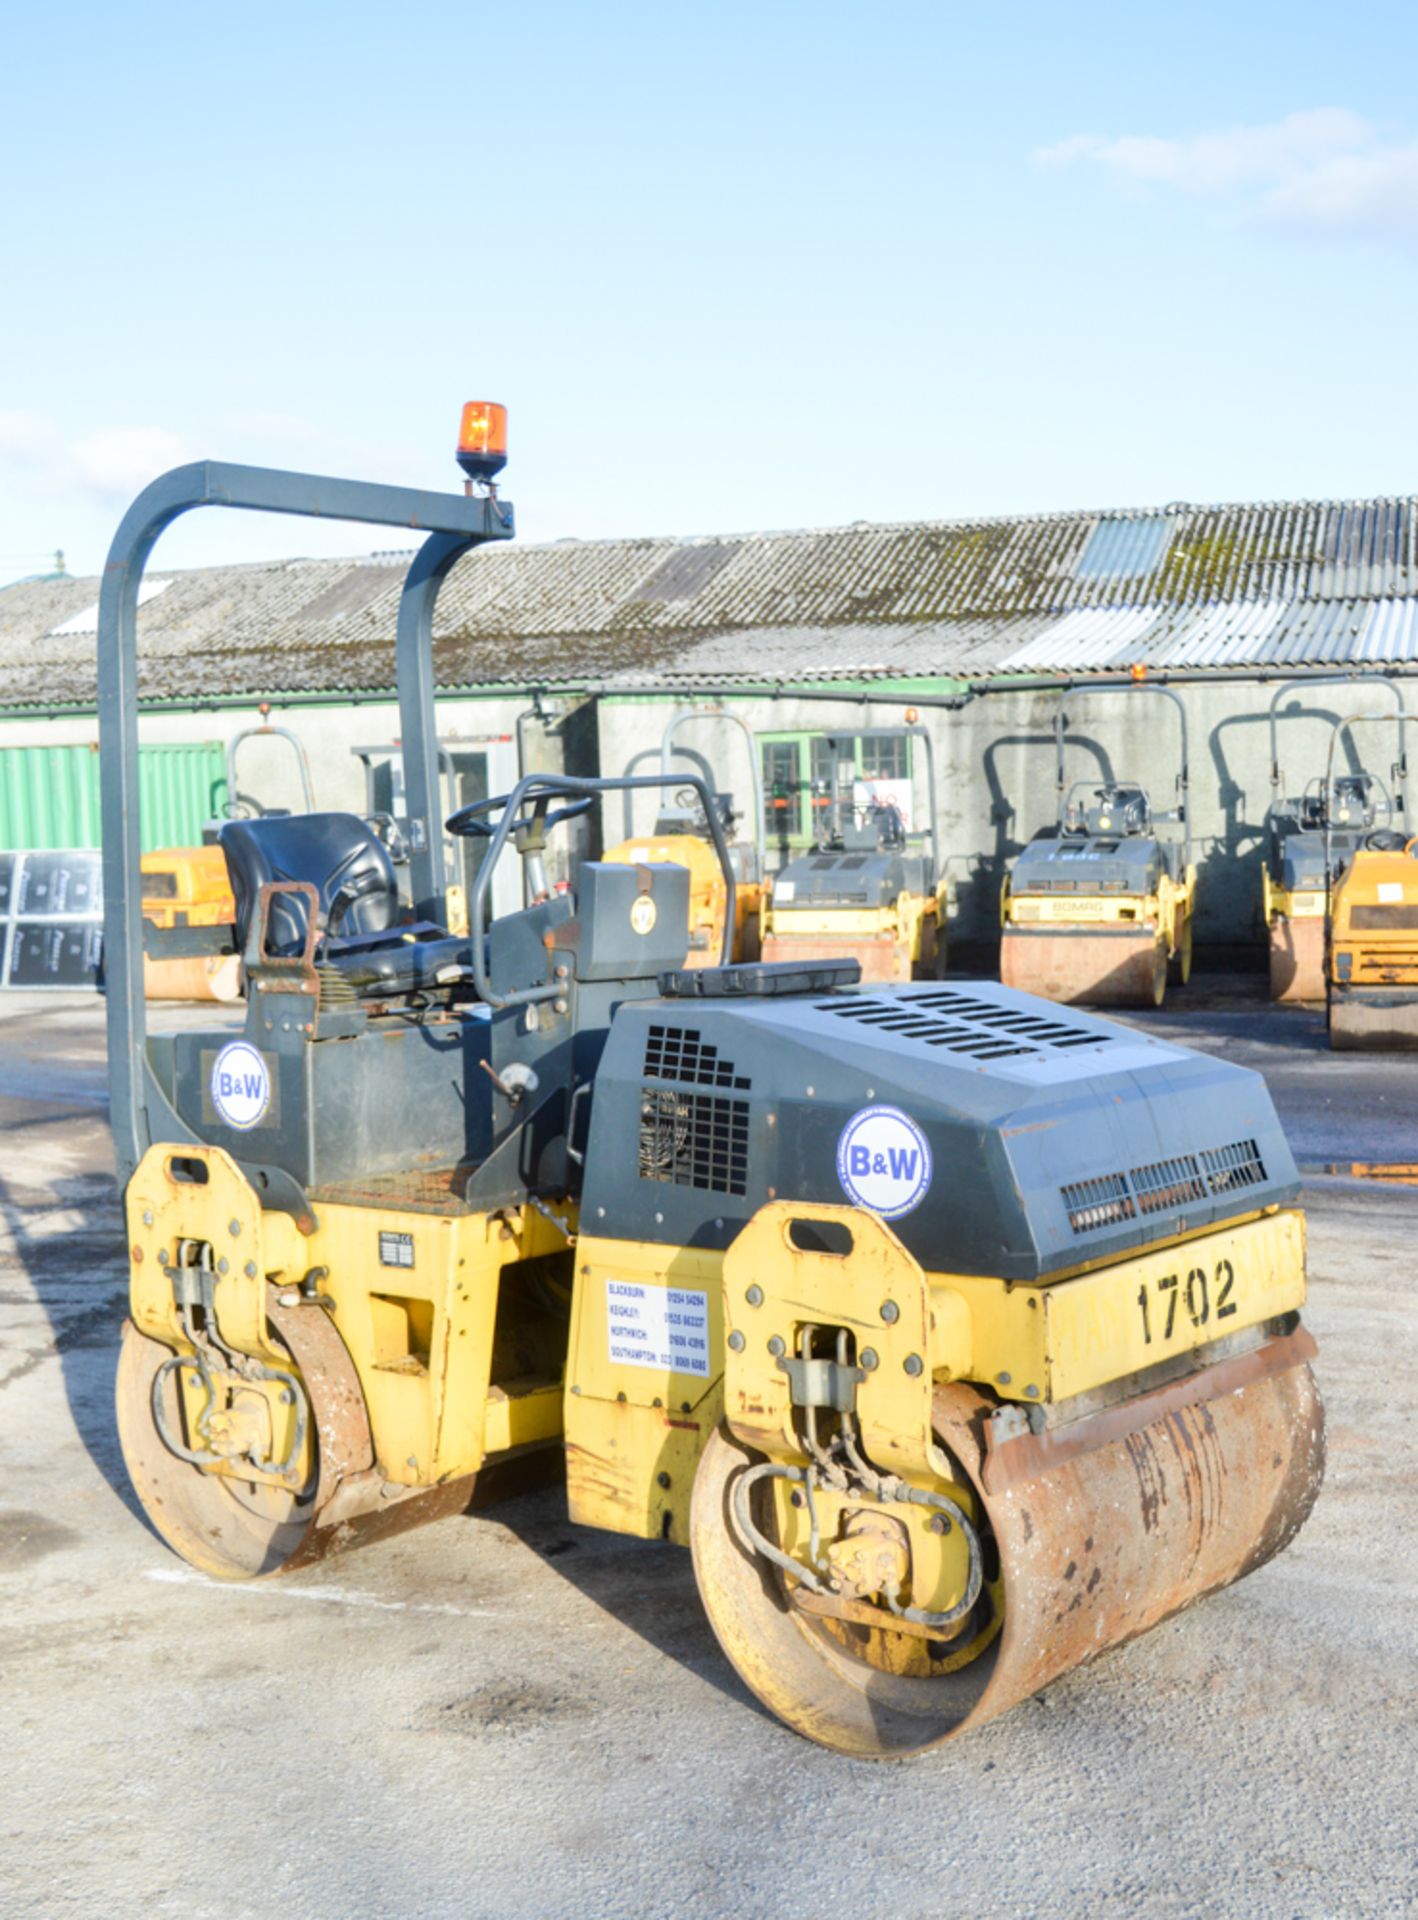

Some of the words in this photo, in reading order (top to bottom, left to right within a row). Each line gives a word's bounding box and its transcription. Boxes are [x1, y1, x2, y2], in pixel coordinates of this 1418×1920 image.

[1052, 901, 1104, 912] BOMAG
[220, 1072, 262, 1099] B&W
[850, 1145, 918, 1181] B&W
[1137, 1258, 1237, 1344] 1702
